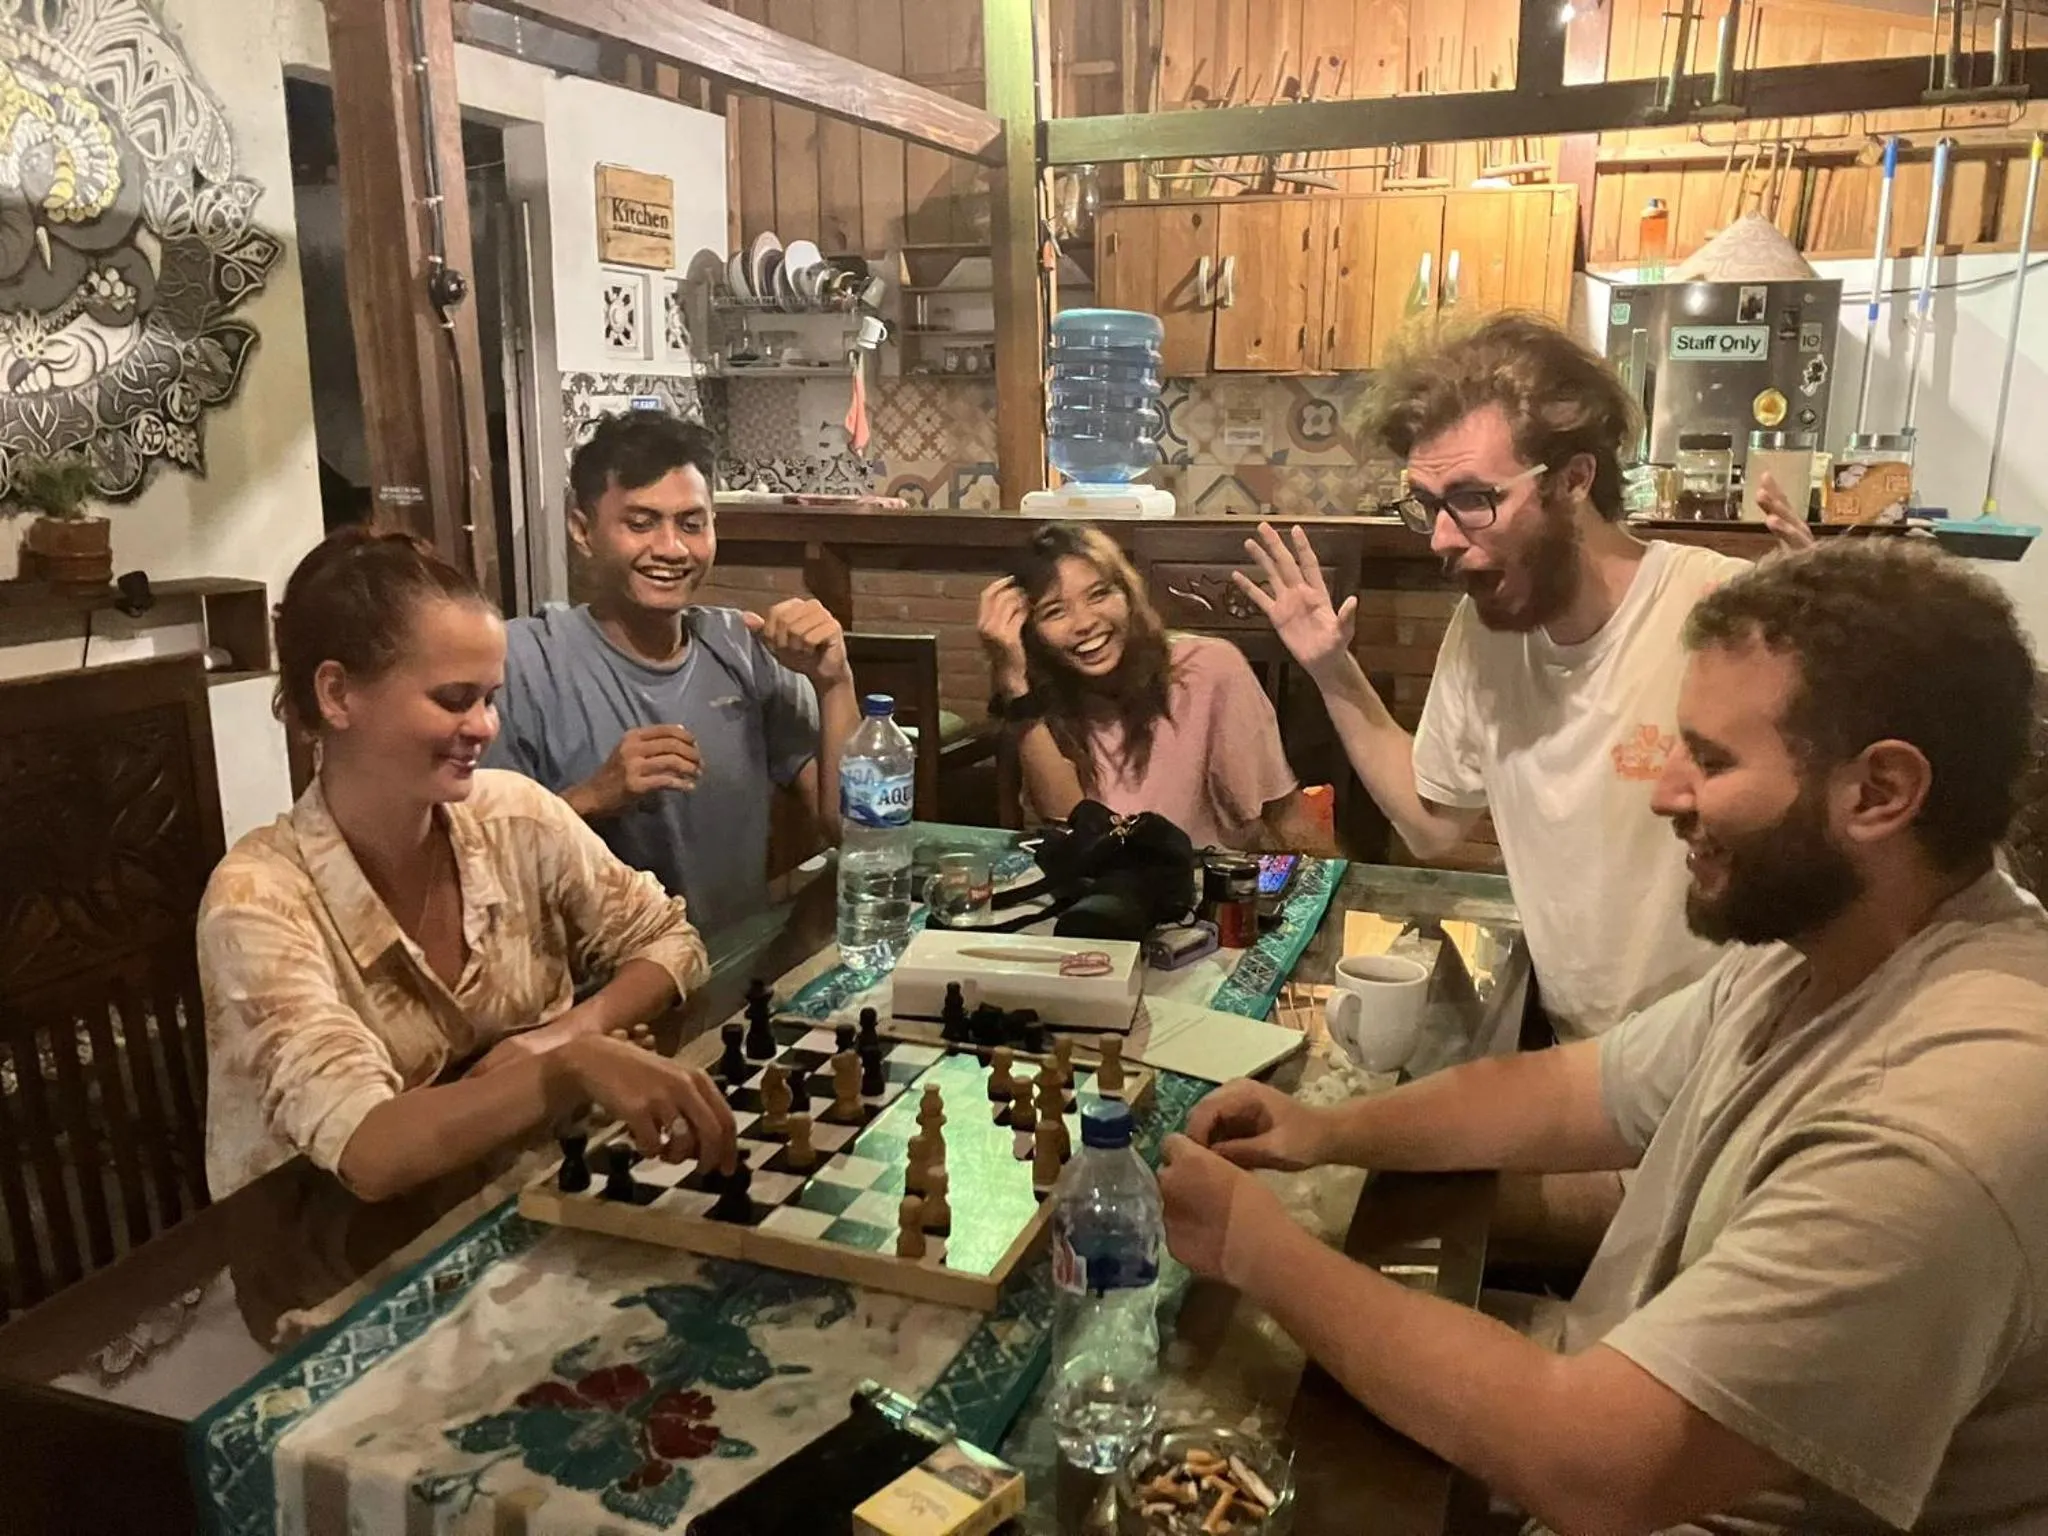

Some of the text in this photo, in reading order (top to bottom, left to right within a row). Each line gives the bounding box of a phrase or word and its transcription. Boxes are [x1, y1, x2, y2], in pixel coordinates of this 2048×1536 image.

[612, 197, 669, 230] Kitchen
[1677, 335, 1762, 354] Staff Only
